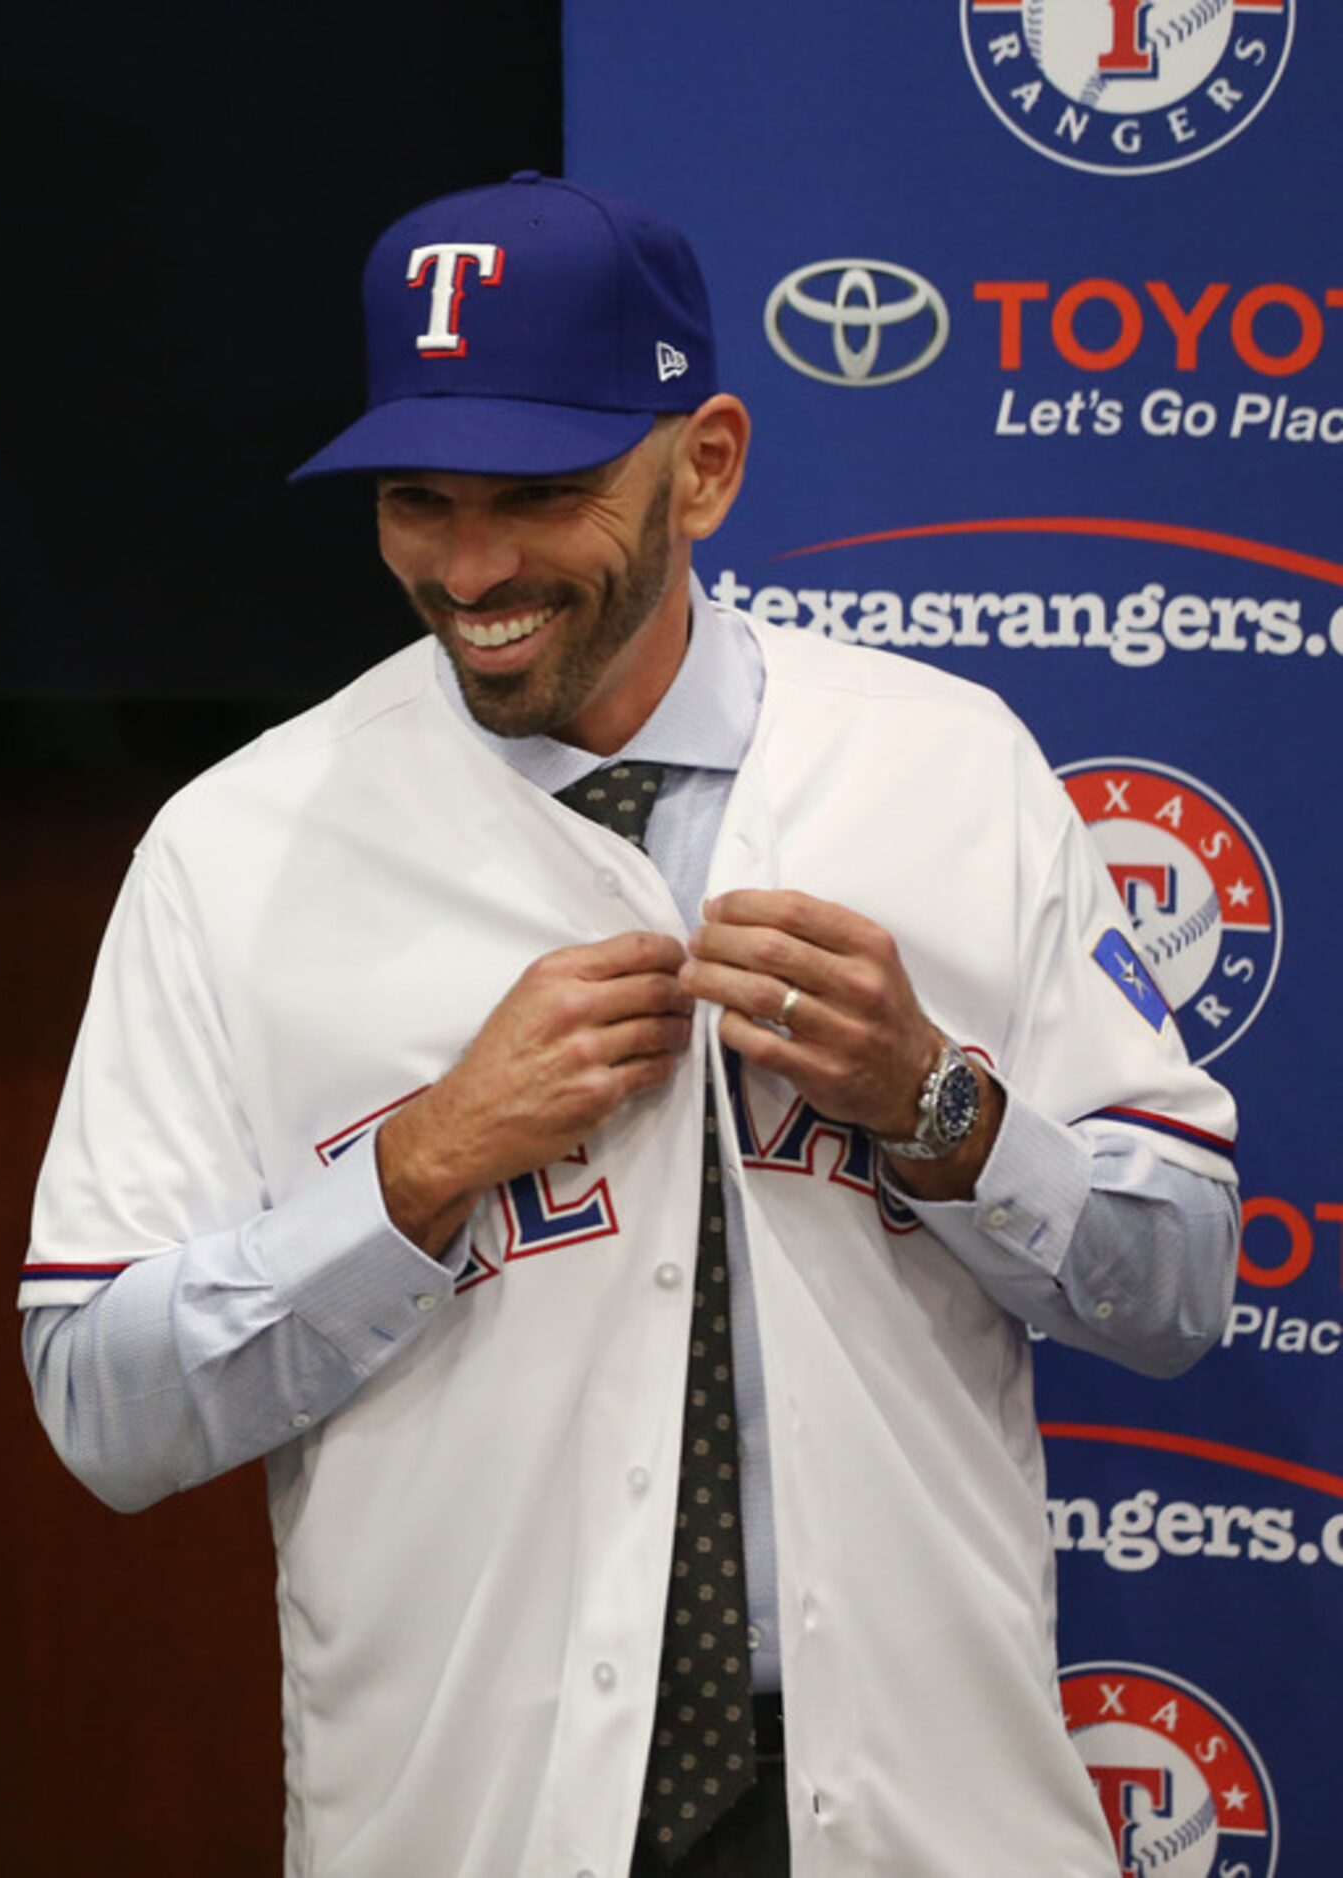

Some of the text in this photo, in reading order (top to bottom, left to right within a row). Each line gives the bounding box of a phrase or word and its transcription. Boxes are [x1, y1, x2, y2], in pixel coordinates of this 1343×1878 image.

[988, 32, 1266, 154] RANGERS
[406, 243, 505, 358] T
[974, 278, 1343, 376] TOYO
[995, 390, 1124, 436] Let's
[1141, 389, 1217, 436] Go
[1063, 1684, 1227, 1763] XAS
